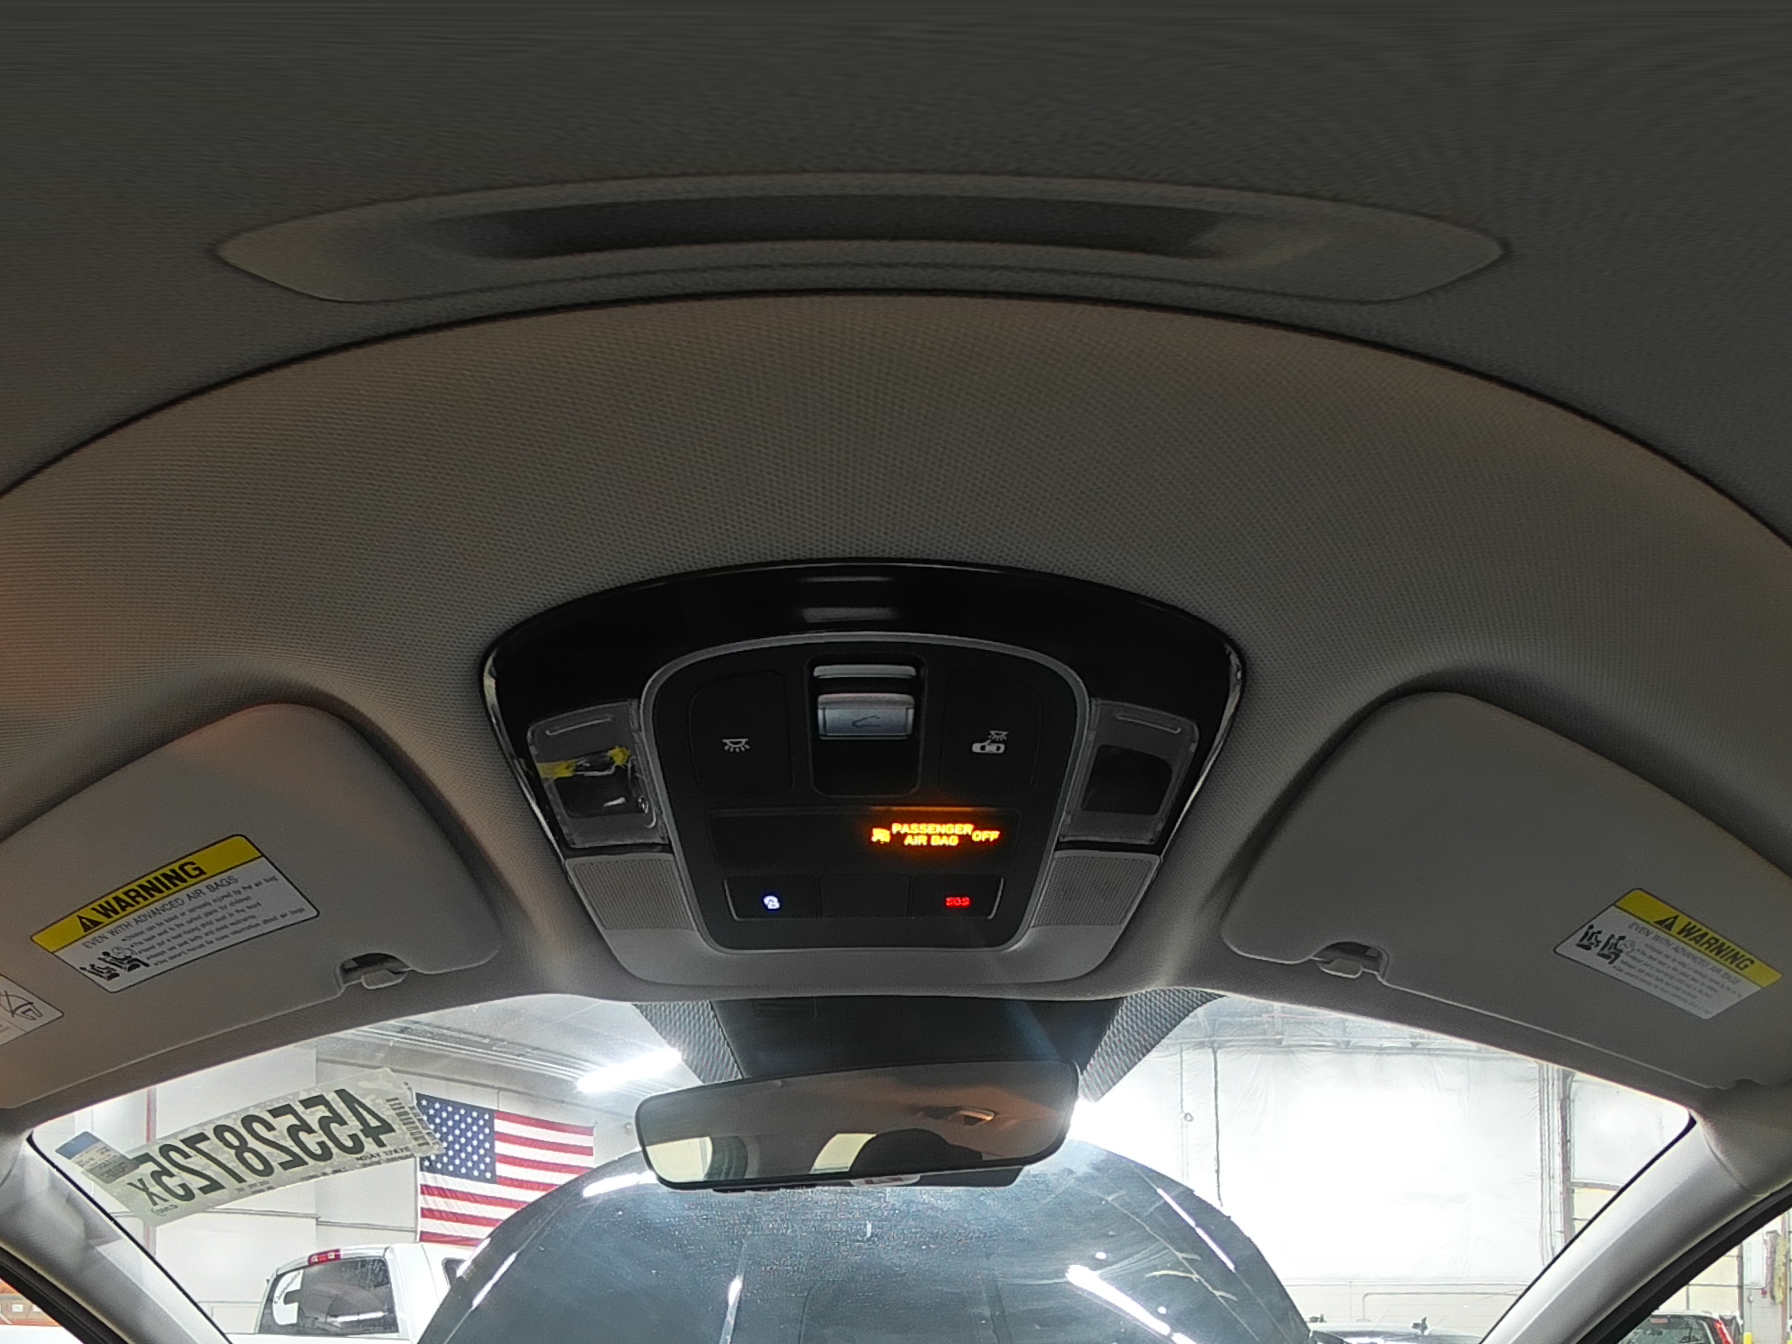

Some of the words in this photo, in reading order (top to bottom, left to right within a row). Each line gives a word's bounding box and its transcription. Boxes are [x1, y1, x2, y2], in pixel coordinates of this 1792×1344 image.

[891, 823, 974, 836] PASSENGER
[971, 830, 1001, 842] OFF
[904, 835, 928, 846] AIR
[930, 835, 959, 846] BAG
[91, 861, 207, 919] WARNING
[80, 933, 109, 949] EVEN
[105, 920, 135, 936] WITH
[130, 896, 186, 925] ADVANCED
[183, 887, 206, 902] AIR
[204, 873, 240, 893] BAGS
[945, 897, 970, 907] SOS
[1627, 921, 1653, 937] EVEN
[1650, 933, 1674, 948] WITH
[1677, 921, 1755, 972] WARNING
